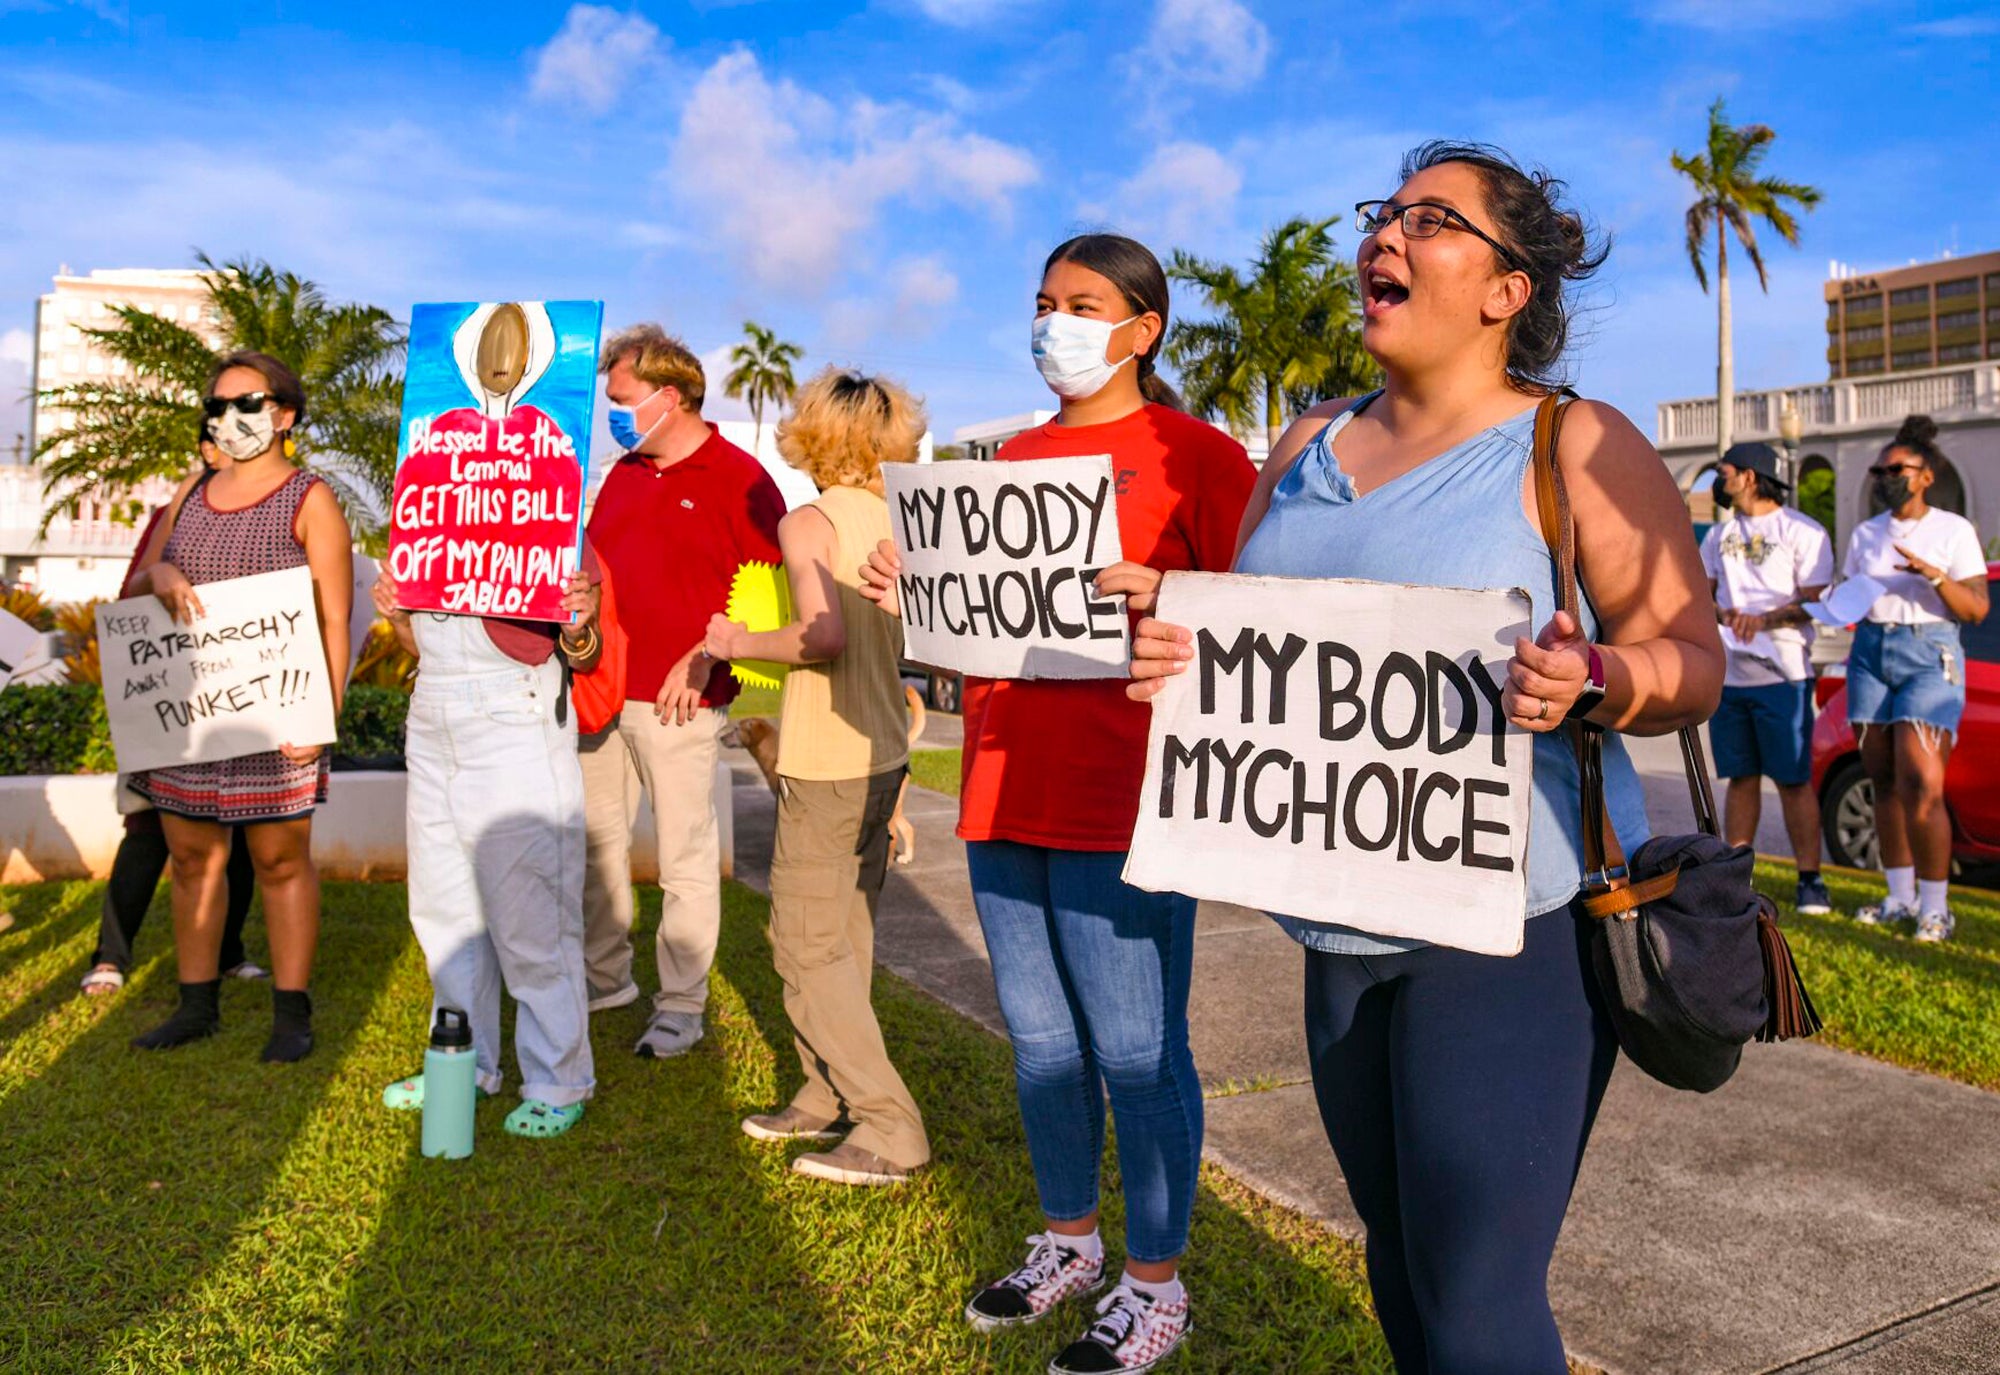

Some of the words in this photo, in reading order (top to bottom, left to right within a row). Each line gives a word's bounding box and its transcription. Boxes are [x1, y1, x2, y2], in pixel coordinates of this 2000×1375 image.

[408, 413, 487, 459] Blessed
[497, 419, 526, 456] be
[530, 415, 576, 459] the
[450, 453, 531, 482] Lemmai
[396, 483, 454, 530] GET
[452, 482, 507, 527] THIS
[512, 486, 573, 526] BILL
[898, 486, 946, 552] MY
[953, 476, 1110, 565] BODY
[390, 534, 445, 583] OFF
[446, 538, 491, 581] MY
[440, 578, 536, 614] JABLO!
[103, 615, 150, 638] KEEP
[128, 610, 304, 666] PATRIARCHY
[123, 669, 169, 701] AWAY
[189, 657, 233, 681] FROM
[258, 643, 289, 664] MY
[1197, 626, 1308, 725] MY
[1317, 640, 1507, 768] BODY
